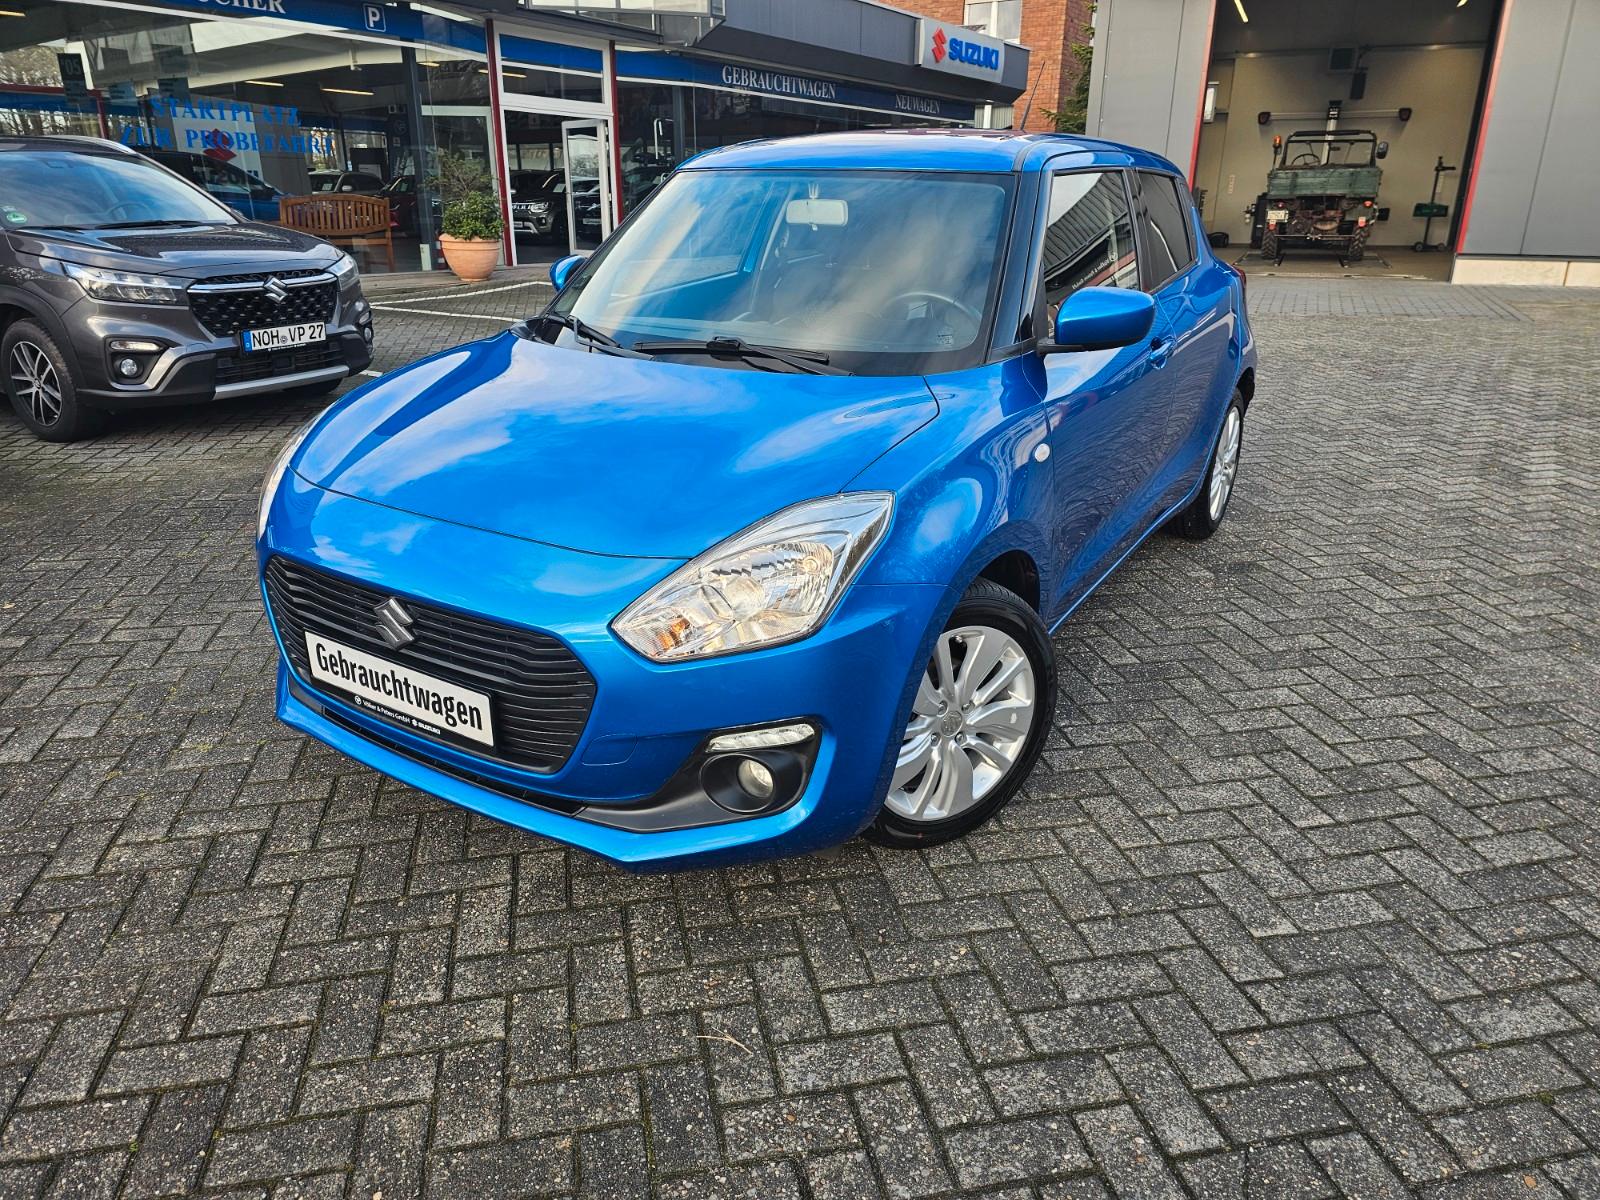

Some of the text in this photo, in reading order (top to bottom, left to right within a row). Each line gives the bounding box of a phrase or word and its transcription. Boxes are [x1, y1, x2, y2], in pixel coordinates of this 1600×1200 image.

[367, 7, 380, 28] P
[949, 38, 999, 70] SUZUKI
[722, 65, 836, 99] GEBRAUCHTWAGEN
[894, 94, 941, 115] NEUWAGEN
[252, 325, 323, 347] NOH VP 27
[315, 643, 483, 731] Gebrauchtwagen
